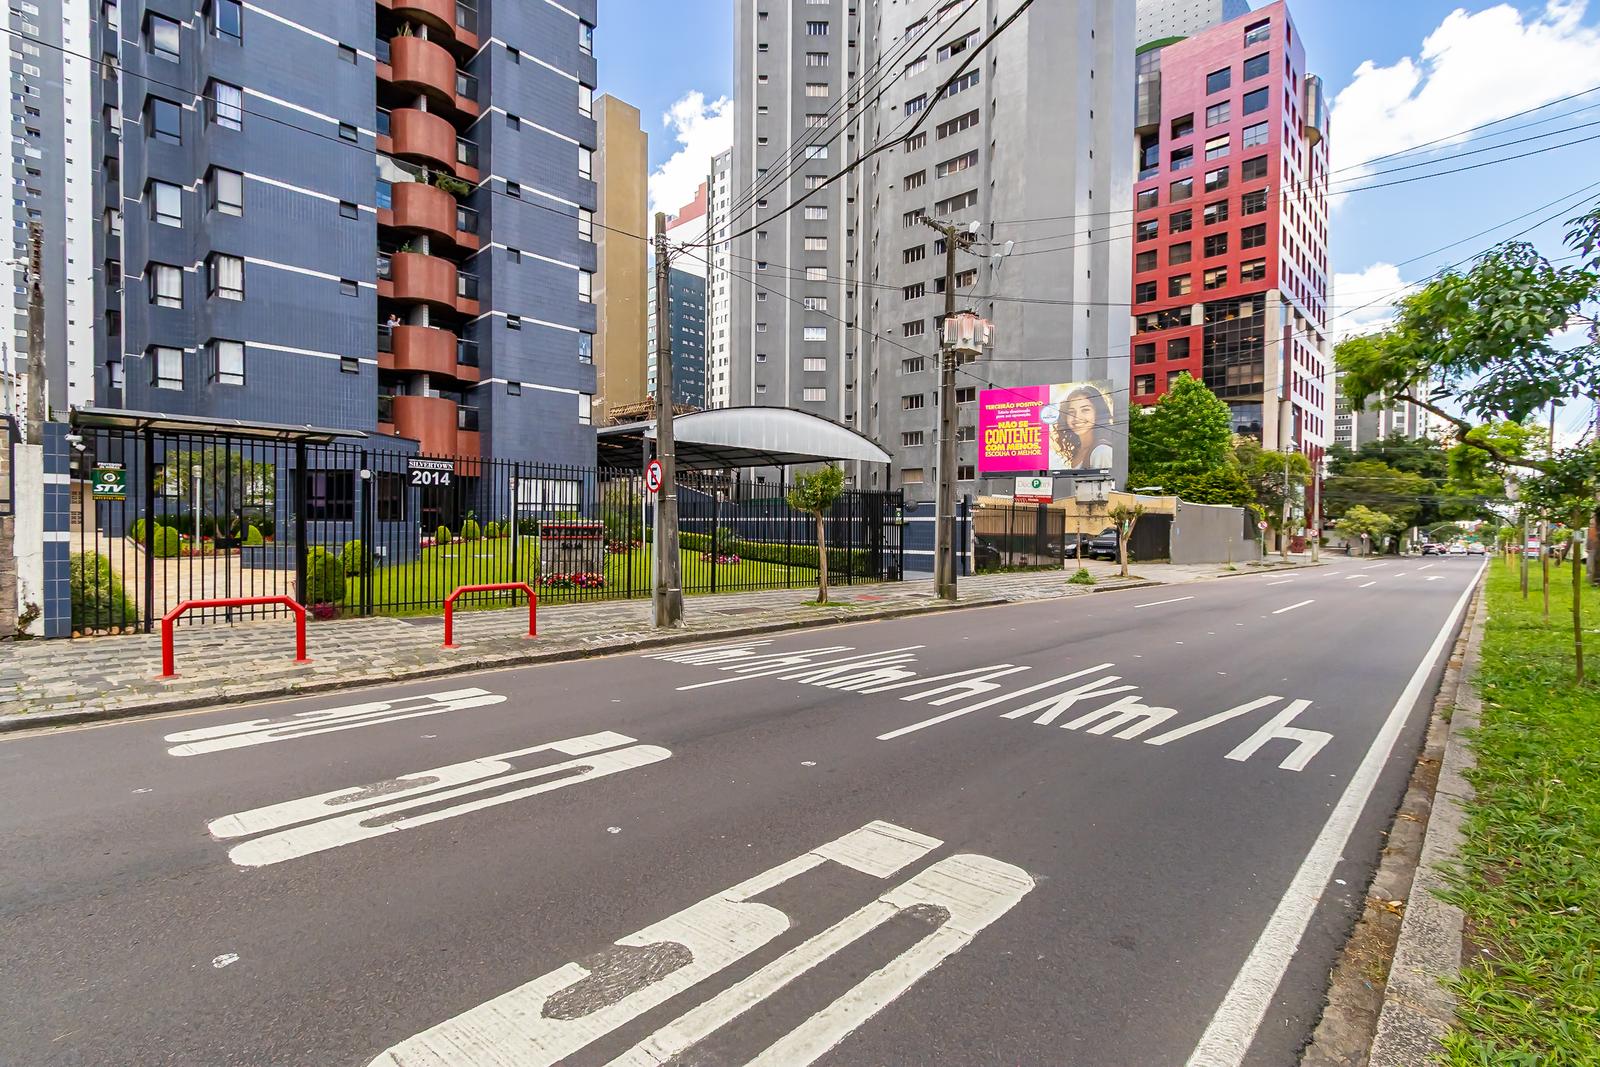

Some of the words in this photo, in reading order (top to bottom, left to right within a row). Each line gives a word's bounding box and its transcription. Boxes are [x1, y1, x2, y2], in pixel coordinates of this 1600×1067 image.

[998, 420, 1017, 428] NÃO
[985, 427, 1042, 444] CONTENTE
[1007, 443, 1042, 451] MENOS.
[408, 461, 454, 470] SILVERTOWN
[411, 470, 451, 486] 2014
[93, 483, 126, 493] STV
[208, 730, 672, 867] 50
